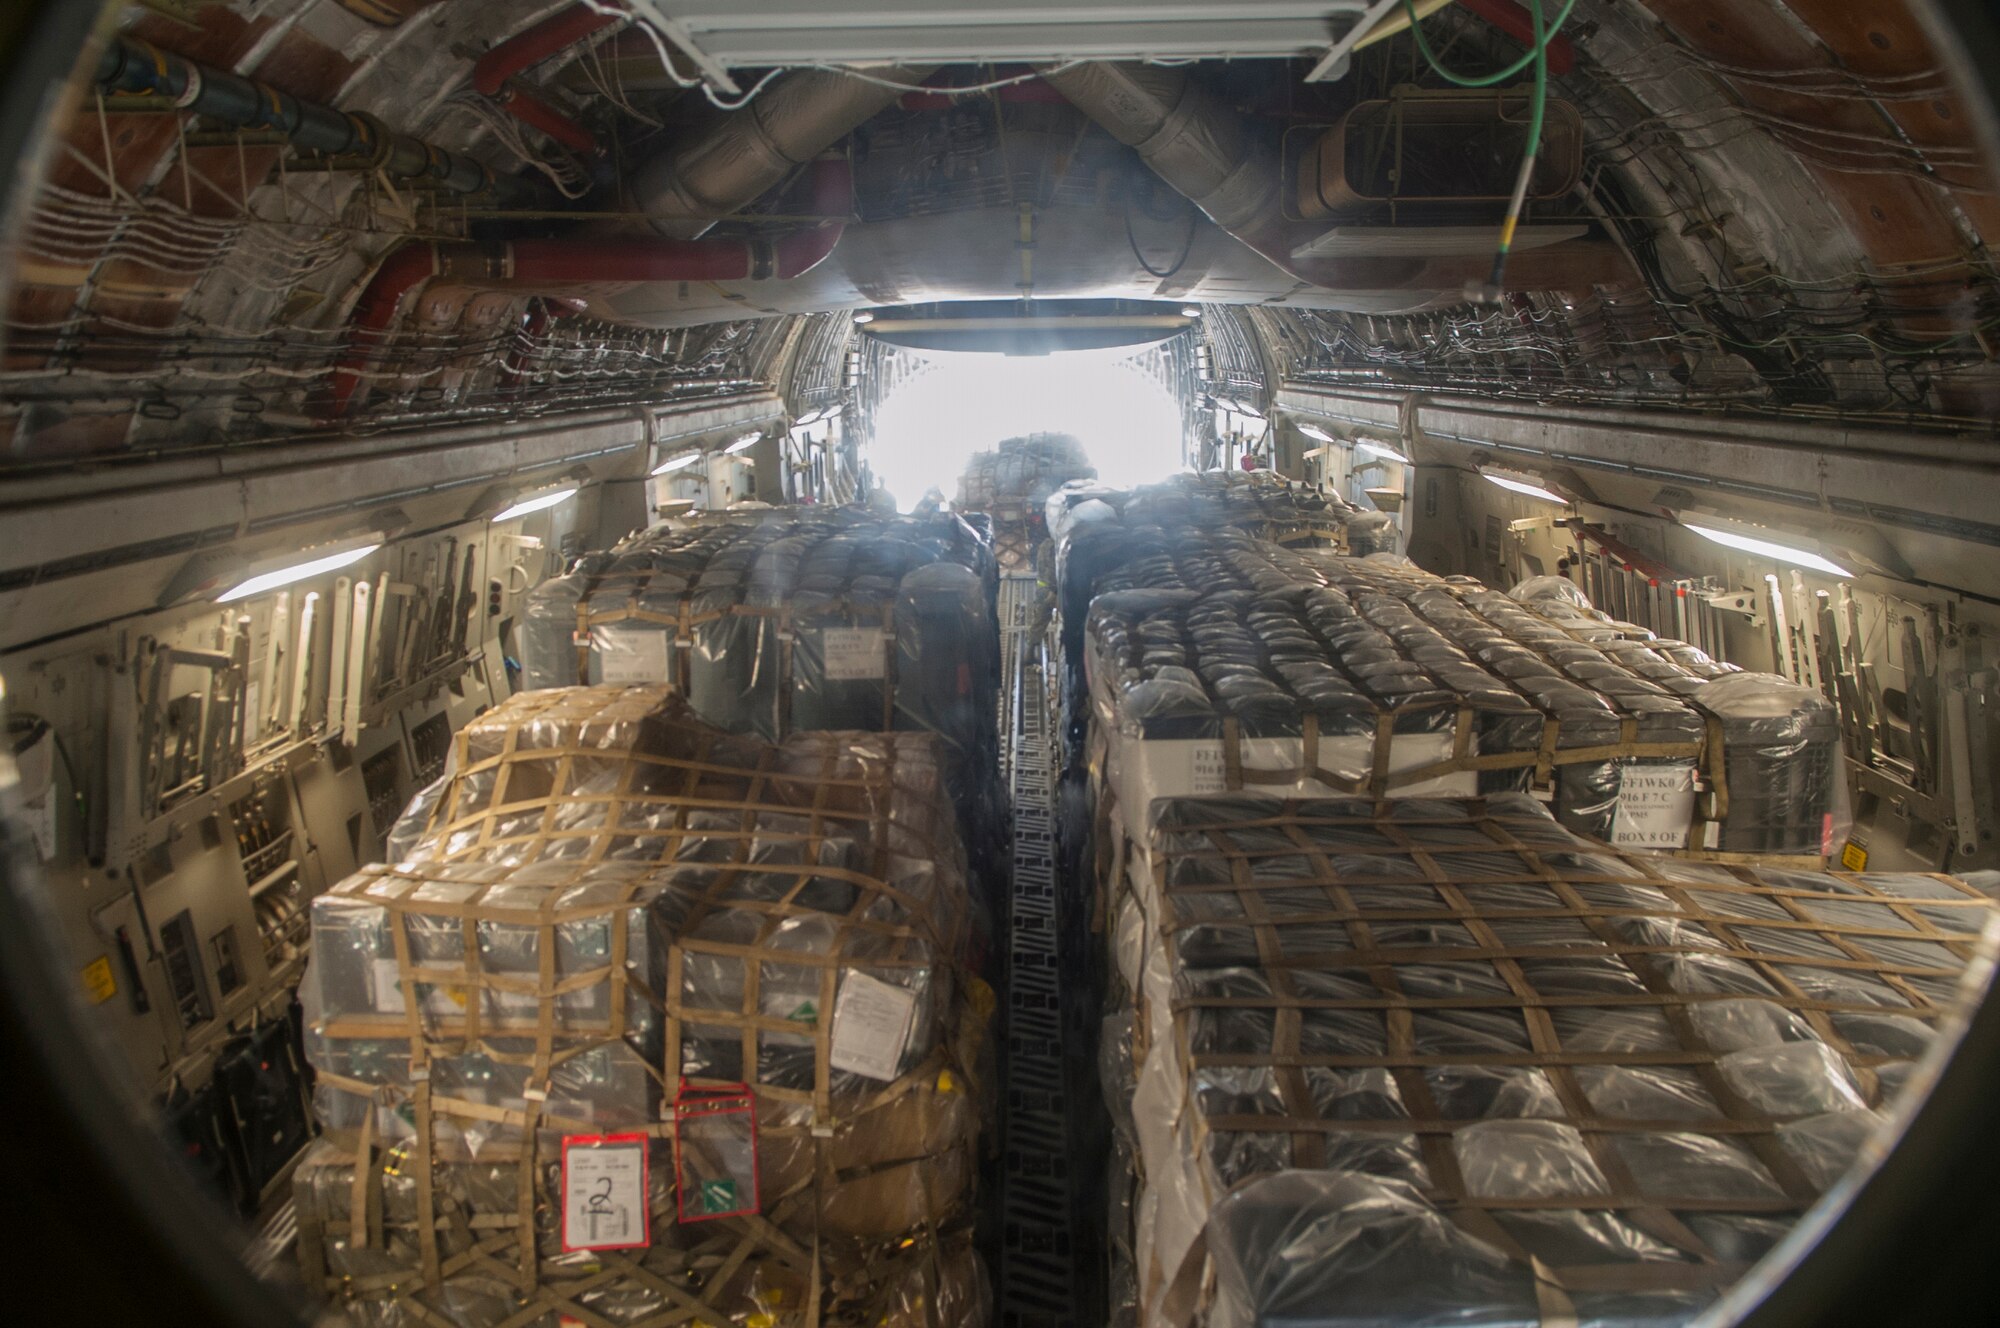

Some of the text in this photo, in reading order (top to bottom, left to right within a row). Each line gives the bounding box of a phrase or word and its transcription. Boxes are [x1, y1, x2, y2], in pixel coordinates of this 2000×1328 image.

[1620, 792, 1671, 802] 916 F 7 C
[1617, 832, 1646, 842] BOX
[1649, 832, 1657, 842] 8
[1659, 832, 1679, 842] OF
[589, 1177, 612, 1206] 2
